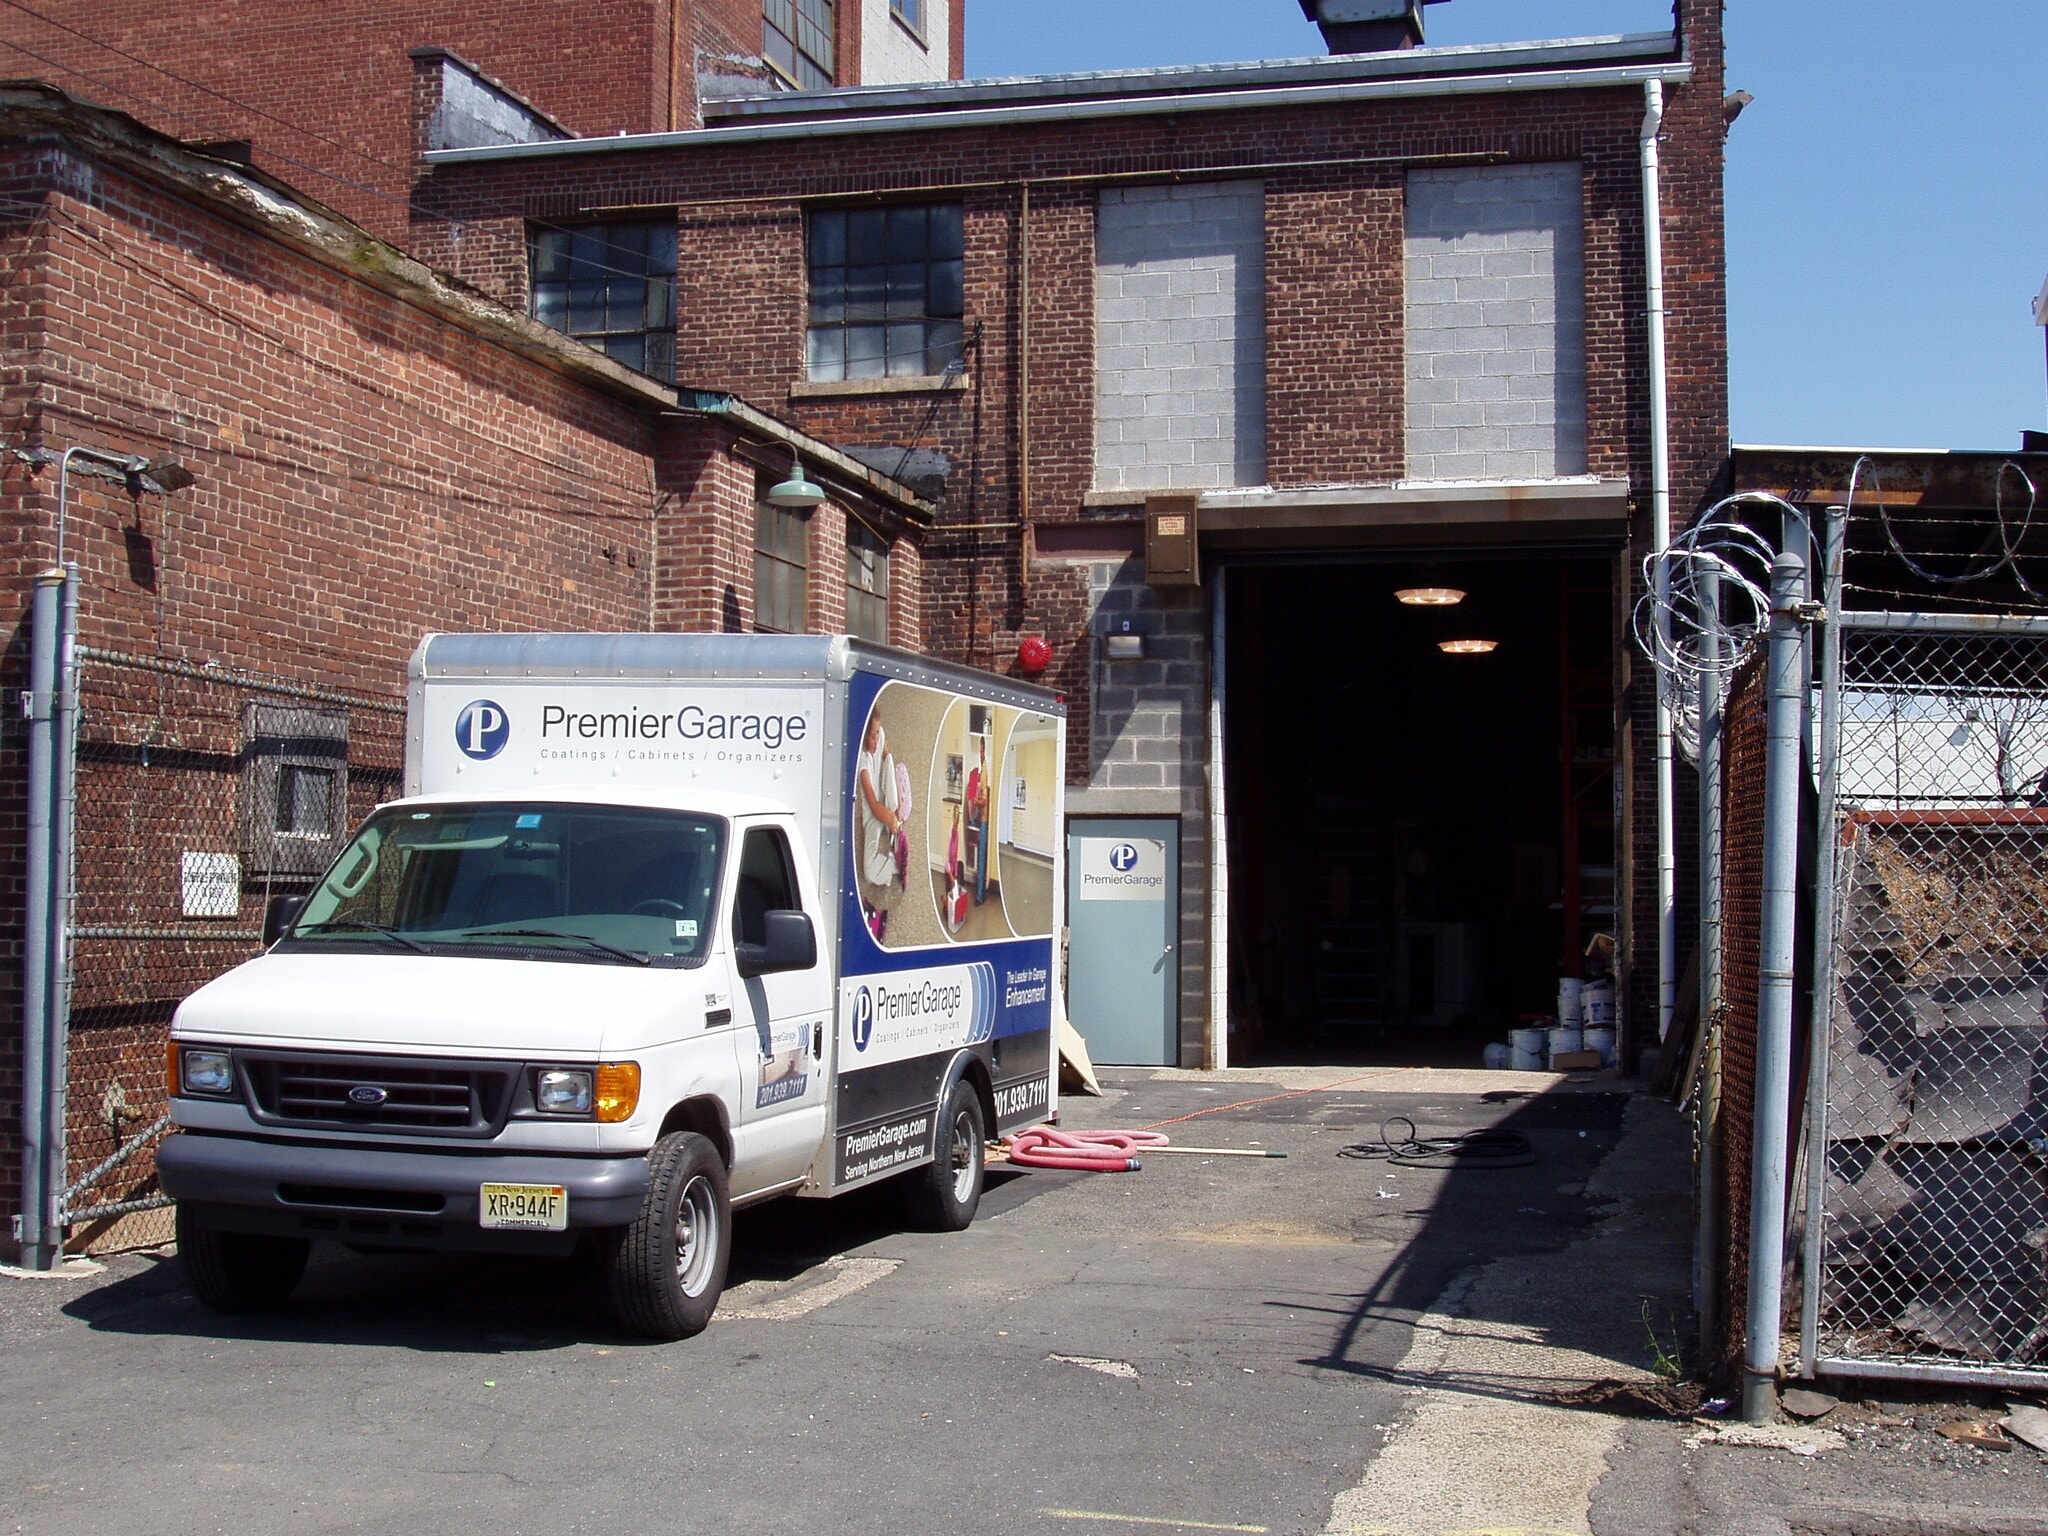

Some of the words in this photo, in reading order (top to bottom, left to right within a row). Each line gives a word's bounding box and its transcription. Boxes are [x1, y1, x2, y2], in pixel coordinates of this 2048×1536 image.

[465, 706, 502, 752] P
[542, 705, 807, 748] PremierGarage
[540, 748, 606, 760] Coatings
[628, 749, 694, 760] Cabinets
[717, 750, 803, 763] Organizers
[1083, 874, 1162, 887] PremierGarage
[877, 981, 961, 1021] PremierGarage
[1005, 983, 1046, 1008] Enhancement
[845, 1118, 927, 1157] PremierGarage.com
[845, 1162, 868, 1180] Serving
[868, 1154, 894, 1172] Northern
[893, 1149, 907, 1163] New
[906, 1144, 925, 1160] Jersey
[502, 1185, 519, 1193] New
[521, 1186, 545, 1195] Jersey
[501, 1218, 545, 1227] COMMERCIAL
